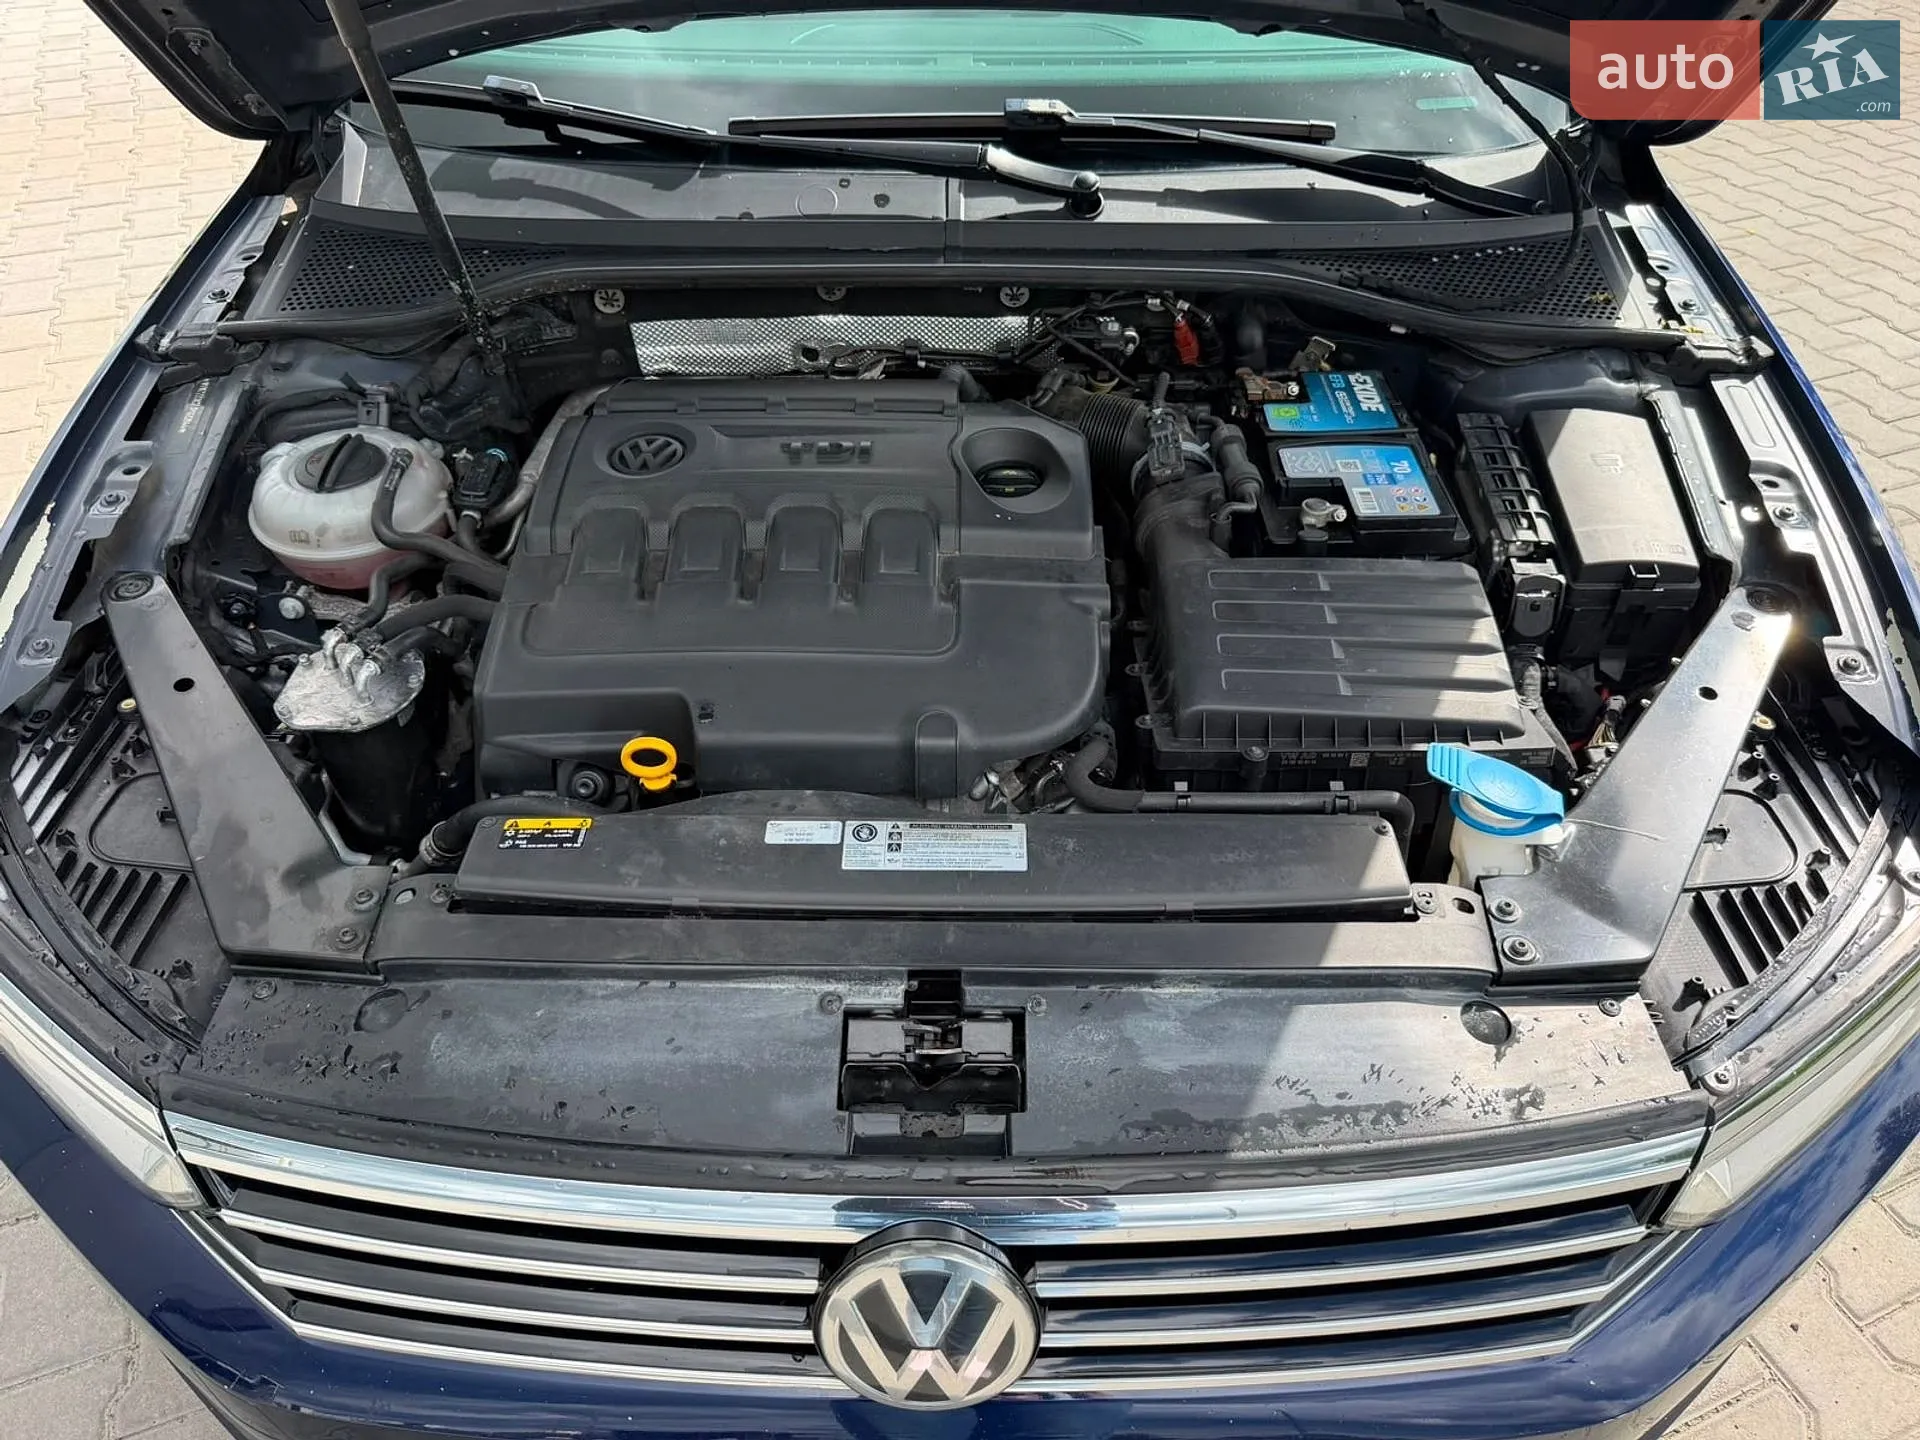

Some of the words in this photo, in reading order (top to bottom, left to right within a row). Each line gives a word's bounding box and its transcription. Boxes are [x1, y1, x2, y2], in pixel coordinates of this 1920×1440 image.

[1347, 372, 1386, 414] EXIDE
[780, 441, 871, 465] TDI
[826, 1256, 1028, 1403] VW
